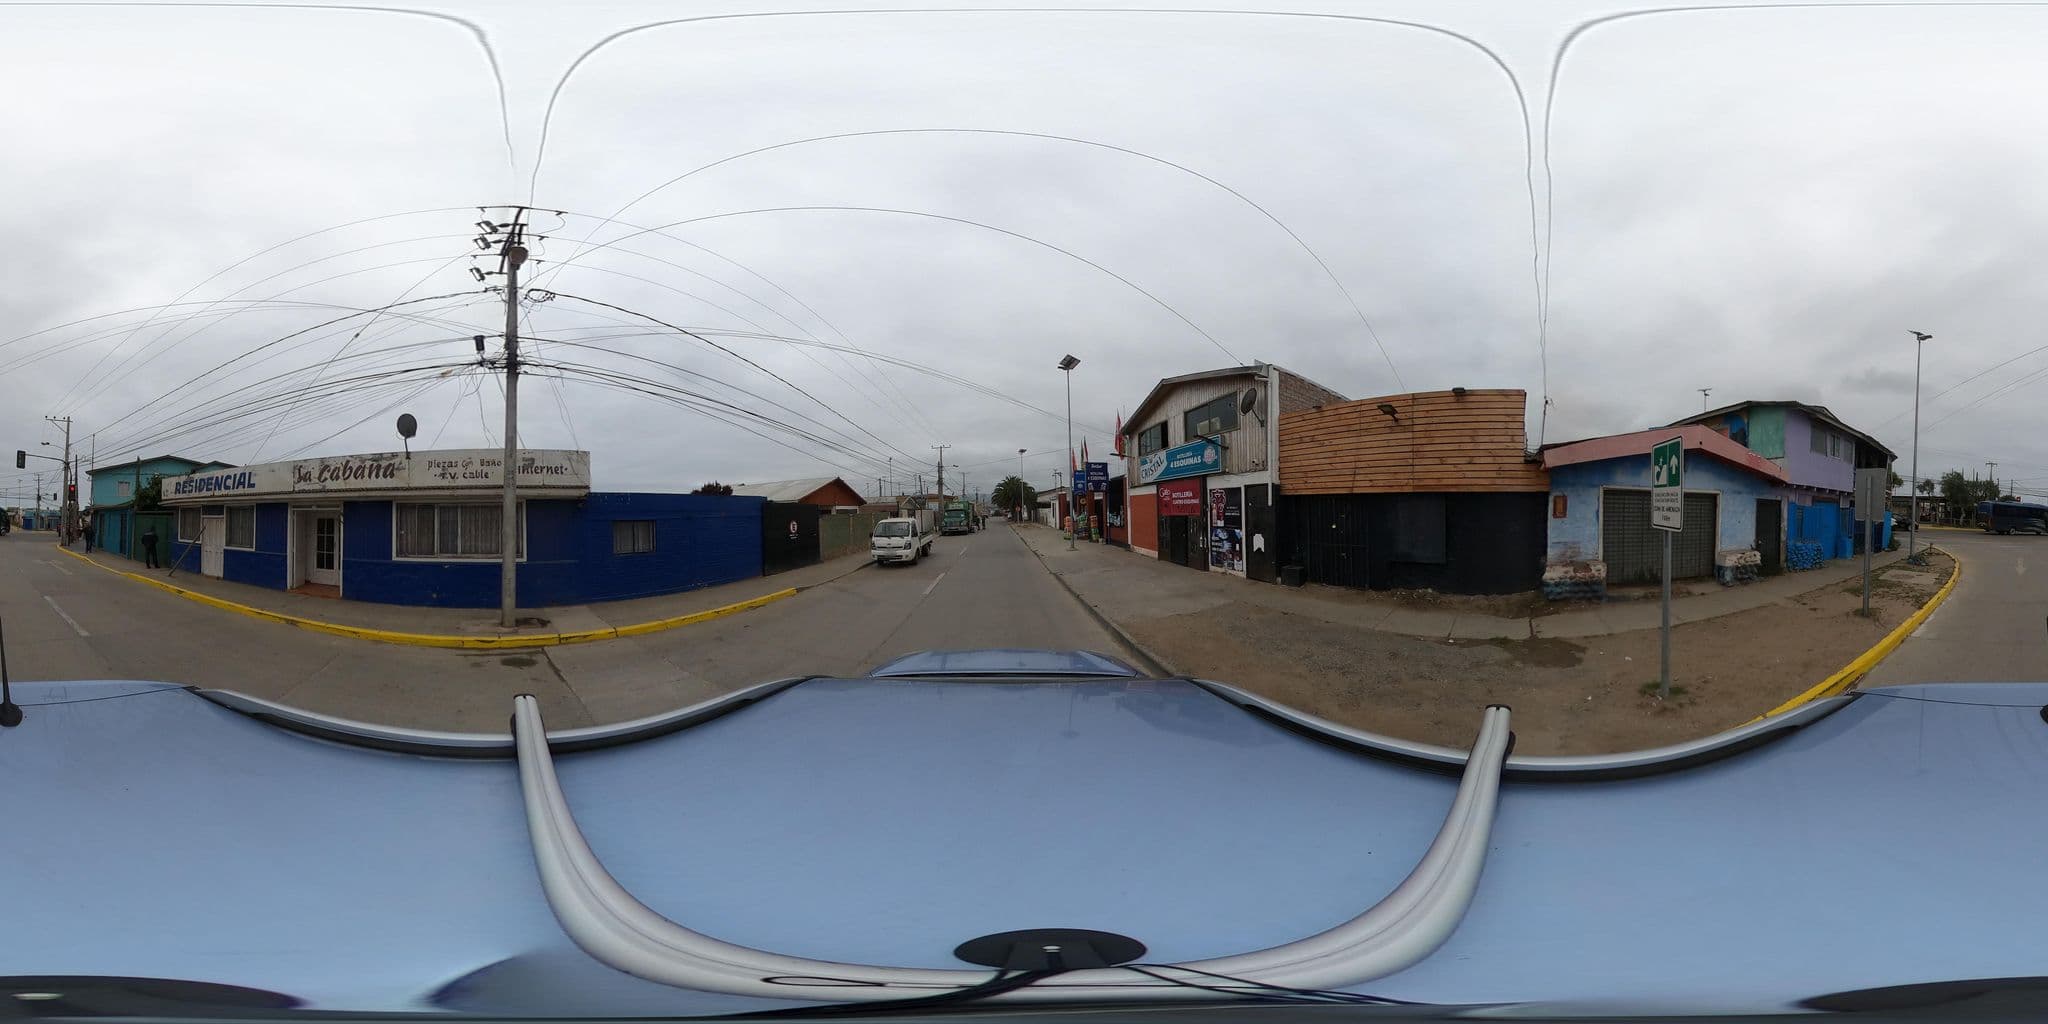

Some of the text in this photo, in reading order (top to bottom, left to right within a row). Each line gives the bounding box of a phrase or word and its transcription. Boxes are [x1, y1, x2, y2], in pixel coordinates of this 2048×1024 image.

[1141, 456, 1163, 479] CRISTAL
[1174, 456, 1202, 468] ESQUINAS
[175, 472, 256, 494] RESIDENCIAL
